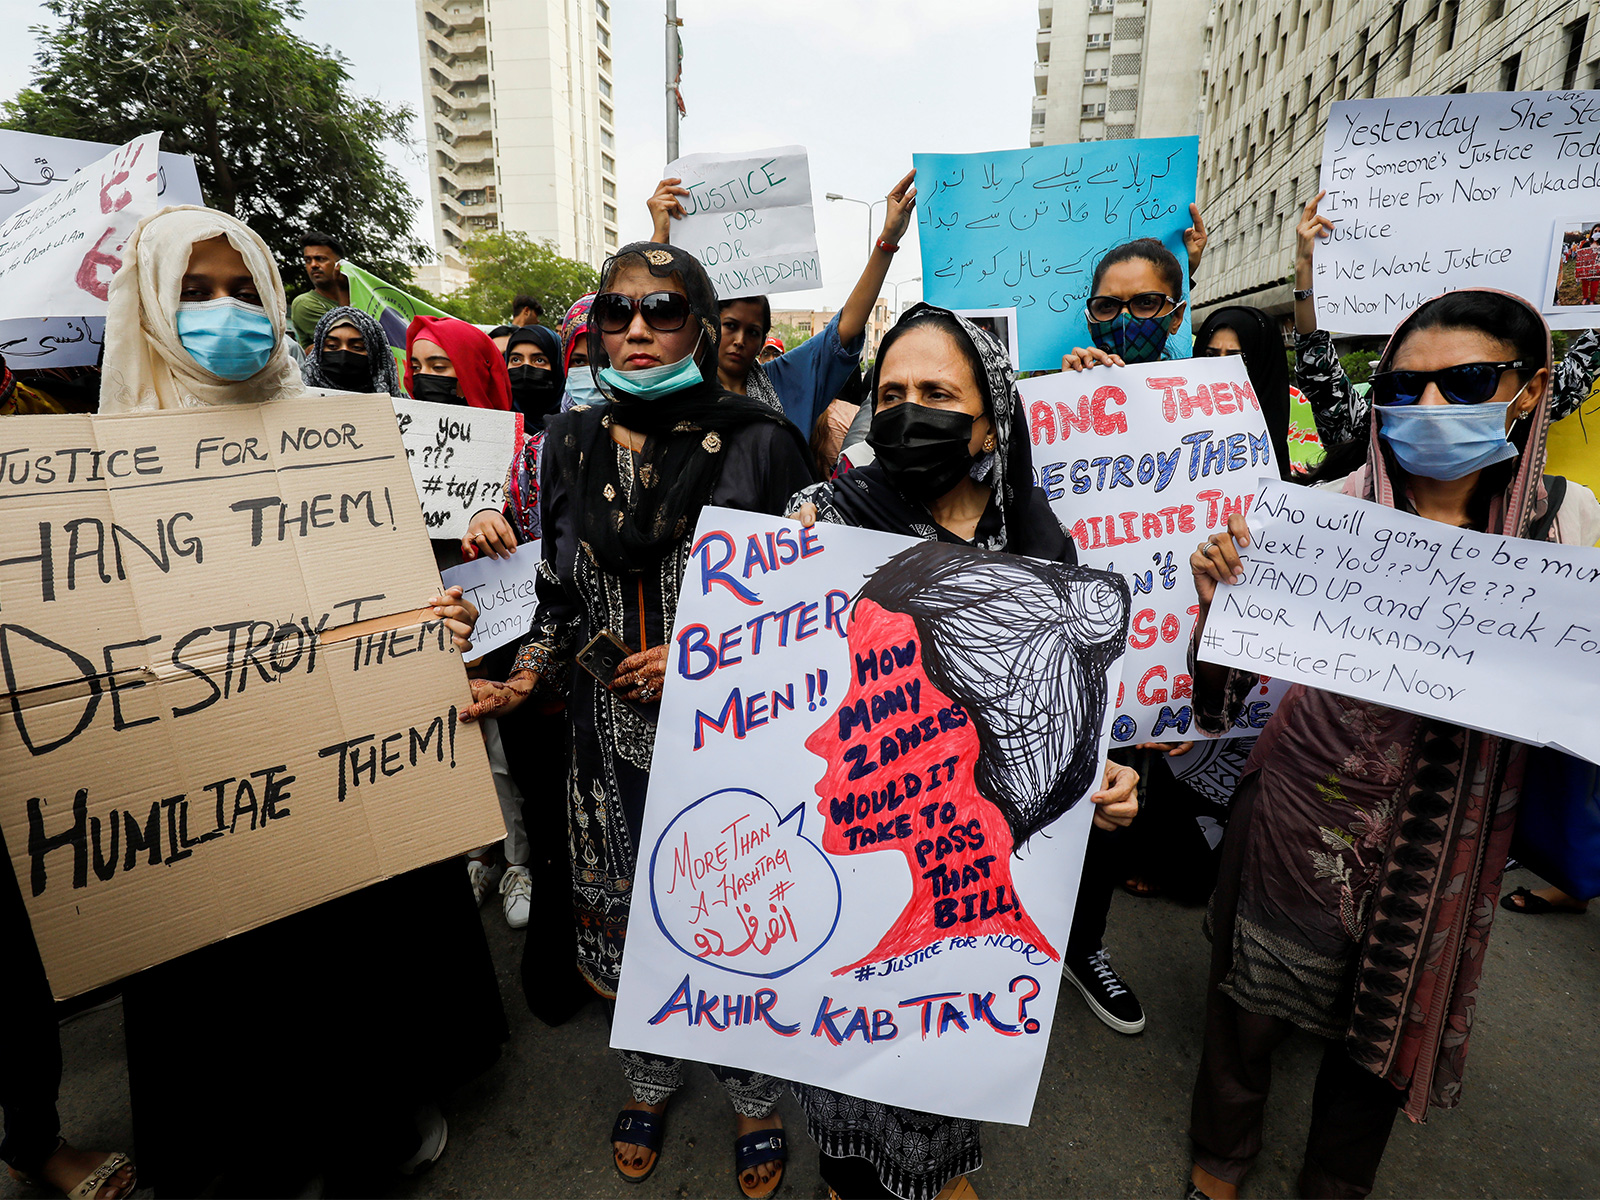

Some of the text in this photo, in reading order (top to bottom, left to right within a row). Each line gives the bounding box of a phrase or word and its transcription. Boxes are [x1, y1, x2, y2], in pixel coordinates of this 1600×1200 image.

[1334, 101, 1479, 154] Yesterday
[1499, 98, 1553, 131] She
[1331, 131, 1600, 182] For Someone's Justice Tod
[684, 159, 786, 215] JUSTICE
[923, 168, 964, 206] نور
[1327, 162, 1600, 212] I'm Here For Noor Mukadd
[723, 208, 762, 235] FOR
[1321, 219, 1392, 246] Justice
[710, 258, 819, 294] MUKADDAM
[1335, 260, 1366, 281] We
[1372, 251, 1432, 279] Want
[1438, 247, 1513, 276] Justice
[1317, 295, 1340, 318] For
[1343, 295, 1380, 316] Noor
[436, 417, 471, 448] you
[1019, 376, 1259, 445] ANG THEM
[0, 422, 363, 485] JUSTICE FOR NOOR
[1033, 447, 1181, 500] ESTROY
[1181, 430, 1270, 481] THEM
[229, 486, 398, 547] THEM!
[1068, 503, 1197, 550] MILIATE
[1254, 486, 1305, 525] Who
[1316, 510, 1364, 537] will
[1371, 527, 1443, 572] going
[1451, 534, 1481, 560] to
[1491, 541, 1529, 571] be
[690, 525, 825, 606] RAISE
[465, 579, 536, 616] Justice
[1224, 593, 1295, 628] NOOR
[1325, 577, 1363, 602] UP
[1363, 594, 1424, 622] and
[1436, 602, 1546, 643] Speak
[1554, 624, 1600, 656] Fo
[676, 588, 851, 681] BETTER
[0, 613, 330, 756] DESTROY
[855, 639, 917, 687] HOW
[838, 678, 921, 742] MANY
[26, 705, 458, 897] HUMILIATE THEM!
[829, 755, 960, 825] WOULD IT
[842, 801, 957, 850] TAKE TO
[914, 818, 986, 868] PASS
[666, 814, 771, 894] MORE THAN
[711, 848, 792, 907] HASHTAG
[922, 855, 997, 898] THAT
[933, 884, 1023, 929] BILL!
[854, 934, 1052, 982] #JUSTICE FOR NOOR
[647, 973, 1042, 1047] AKHIR KAB TAK?
